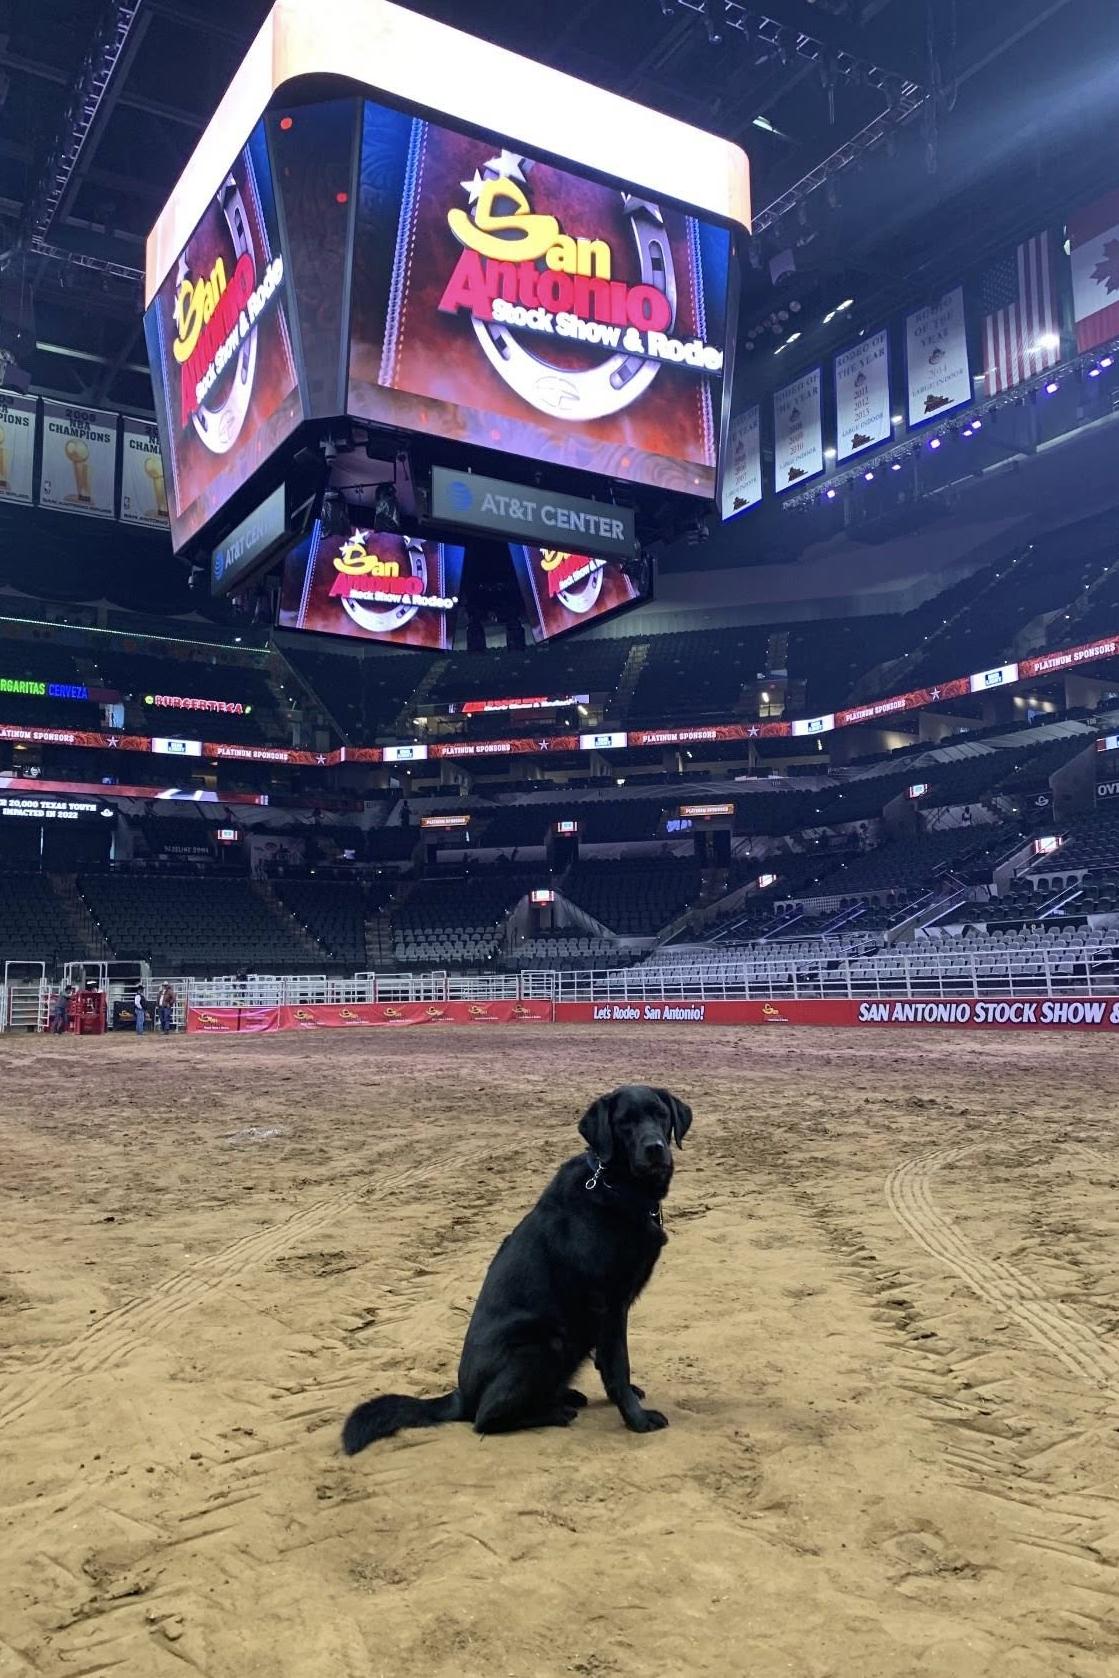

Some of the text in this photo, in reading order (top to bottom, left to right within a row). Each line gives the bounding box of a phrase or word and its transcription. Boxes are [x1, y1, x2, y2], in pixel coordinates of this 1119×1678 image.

[447, 176, 611, 281] San
[437, 247, 672, 333] Antonio
[173, 257, 227, 362] San
[492, 298, 554, 333] Stock
[555, 312, 621, 348] Show
[623, 328, 645, 353] &
[49, 422, 111, 443] CHAMPIONS
[69, 418, 92, 430] NBA
[481, 493, 625, 540] AT&T CENTER
[333, 544, 400, 577] San
[1034, 643, 1116, 671] PLATINUM SPONSORS
[0, 678, 88, 699] RGARITAS CERVEZA
[845, 699, 906, 721] PLATINUM SPONSORS
[33, 731, 75, 743] SPONSORS
[643, 731, 717, 743] PLATINUM SPONSORS
[217, 747, 288, 761] PLATINUM SPONSORS
[442, 743, 511, 755] PLATINUM SPONSORS
[8, 799, 39, 808] 20,000
[46, 810, 56, 818] IN
[57, 811, 79, 819] 2022
[593, 1004, 704, 1021] Let's Rodeo San Antonio!
[859, 1002, 889, 1022] SAN
[892, 1002, 971, 1022] ANTONIO
[973, 1002, 1037, 1023] STOCK
[1040, 1001, 1106, 1024] SHOW
